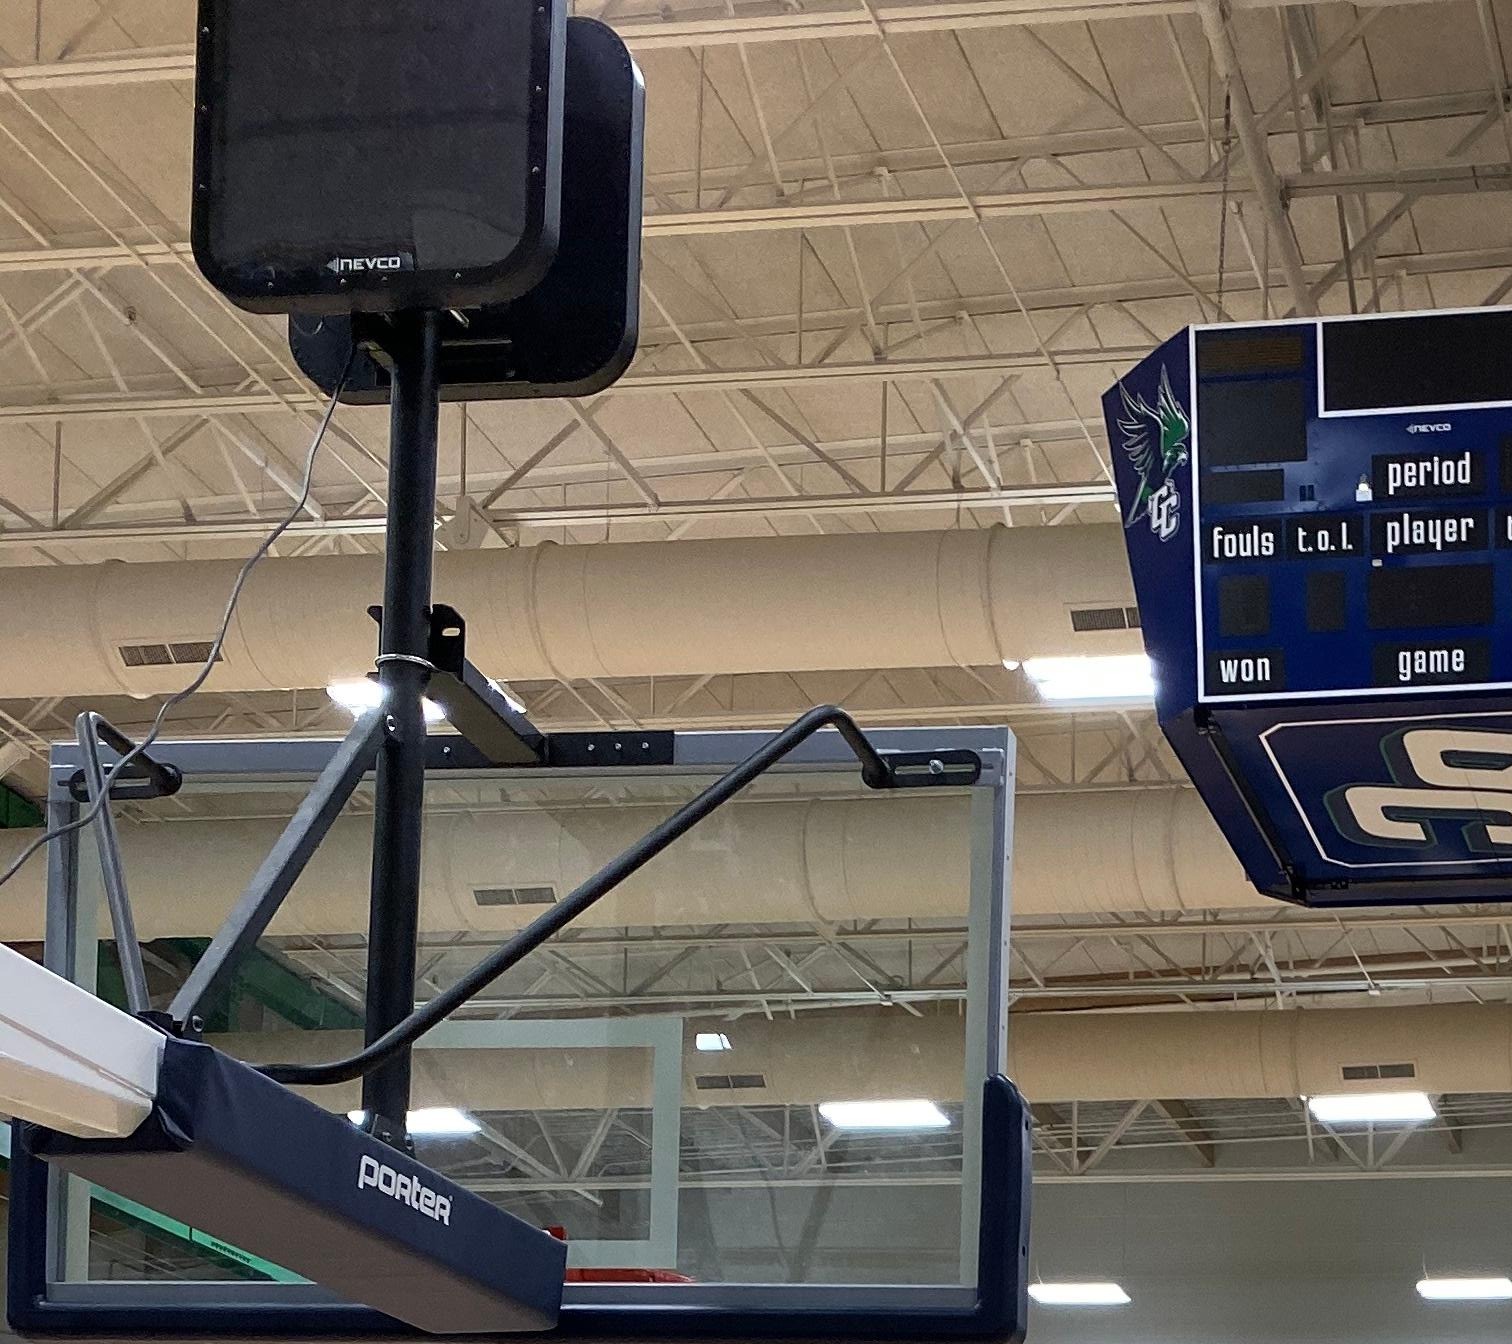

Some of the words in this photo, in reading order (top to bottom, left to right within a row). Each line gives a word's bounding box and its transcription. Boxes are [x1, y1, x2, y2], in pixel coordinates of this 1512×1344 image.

[340, 257, 400, 271] NEVCO
[1388, 452, 1471, 495] period
[1212, 525, 1275, 558] fouls
[1297, 522, 1353, 552] t.o.l.
[1386, 513, 1475, 553] player
[1219, 657, 1271, 683] won
[1398, 648, 1466, 681] game
